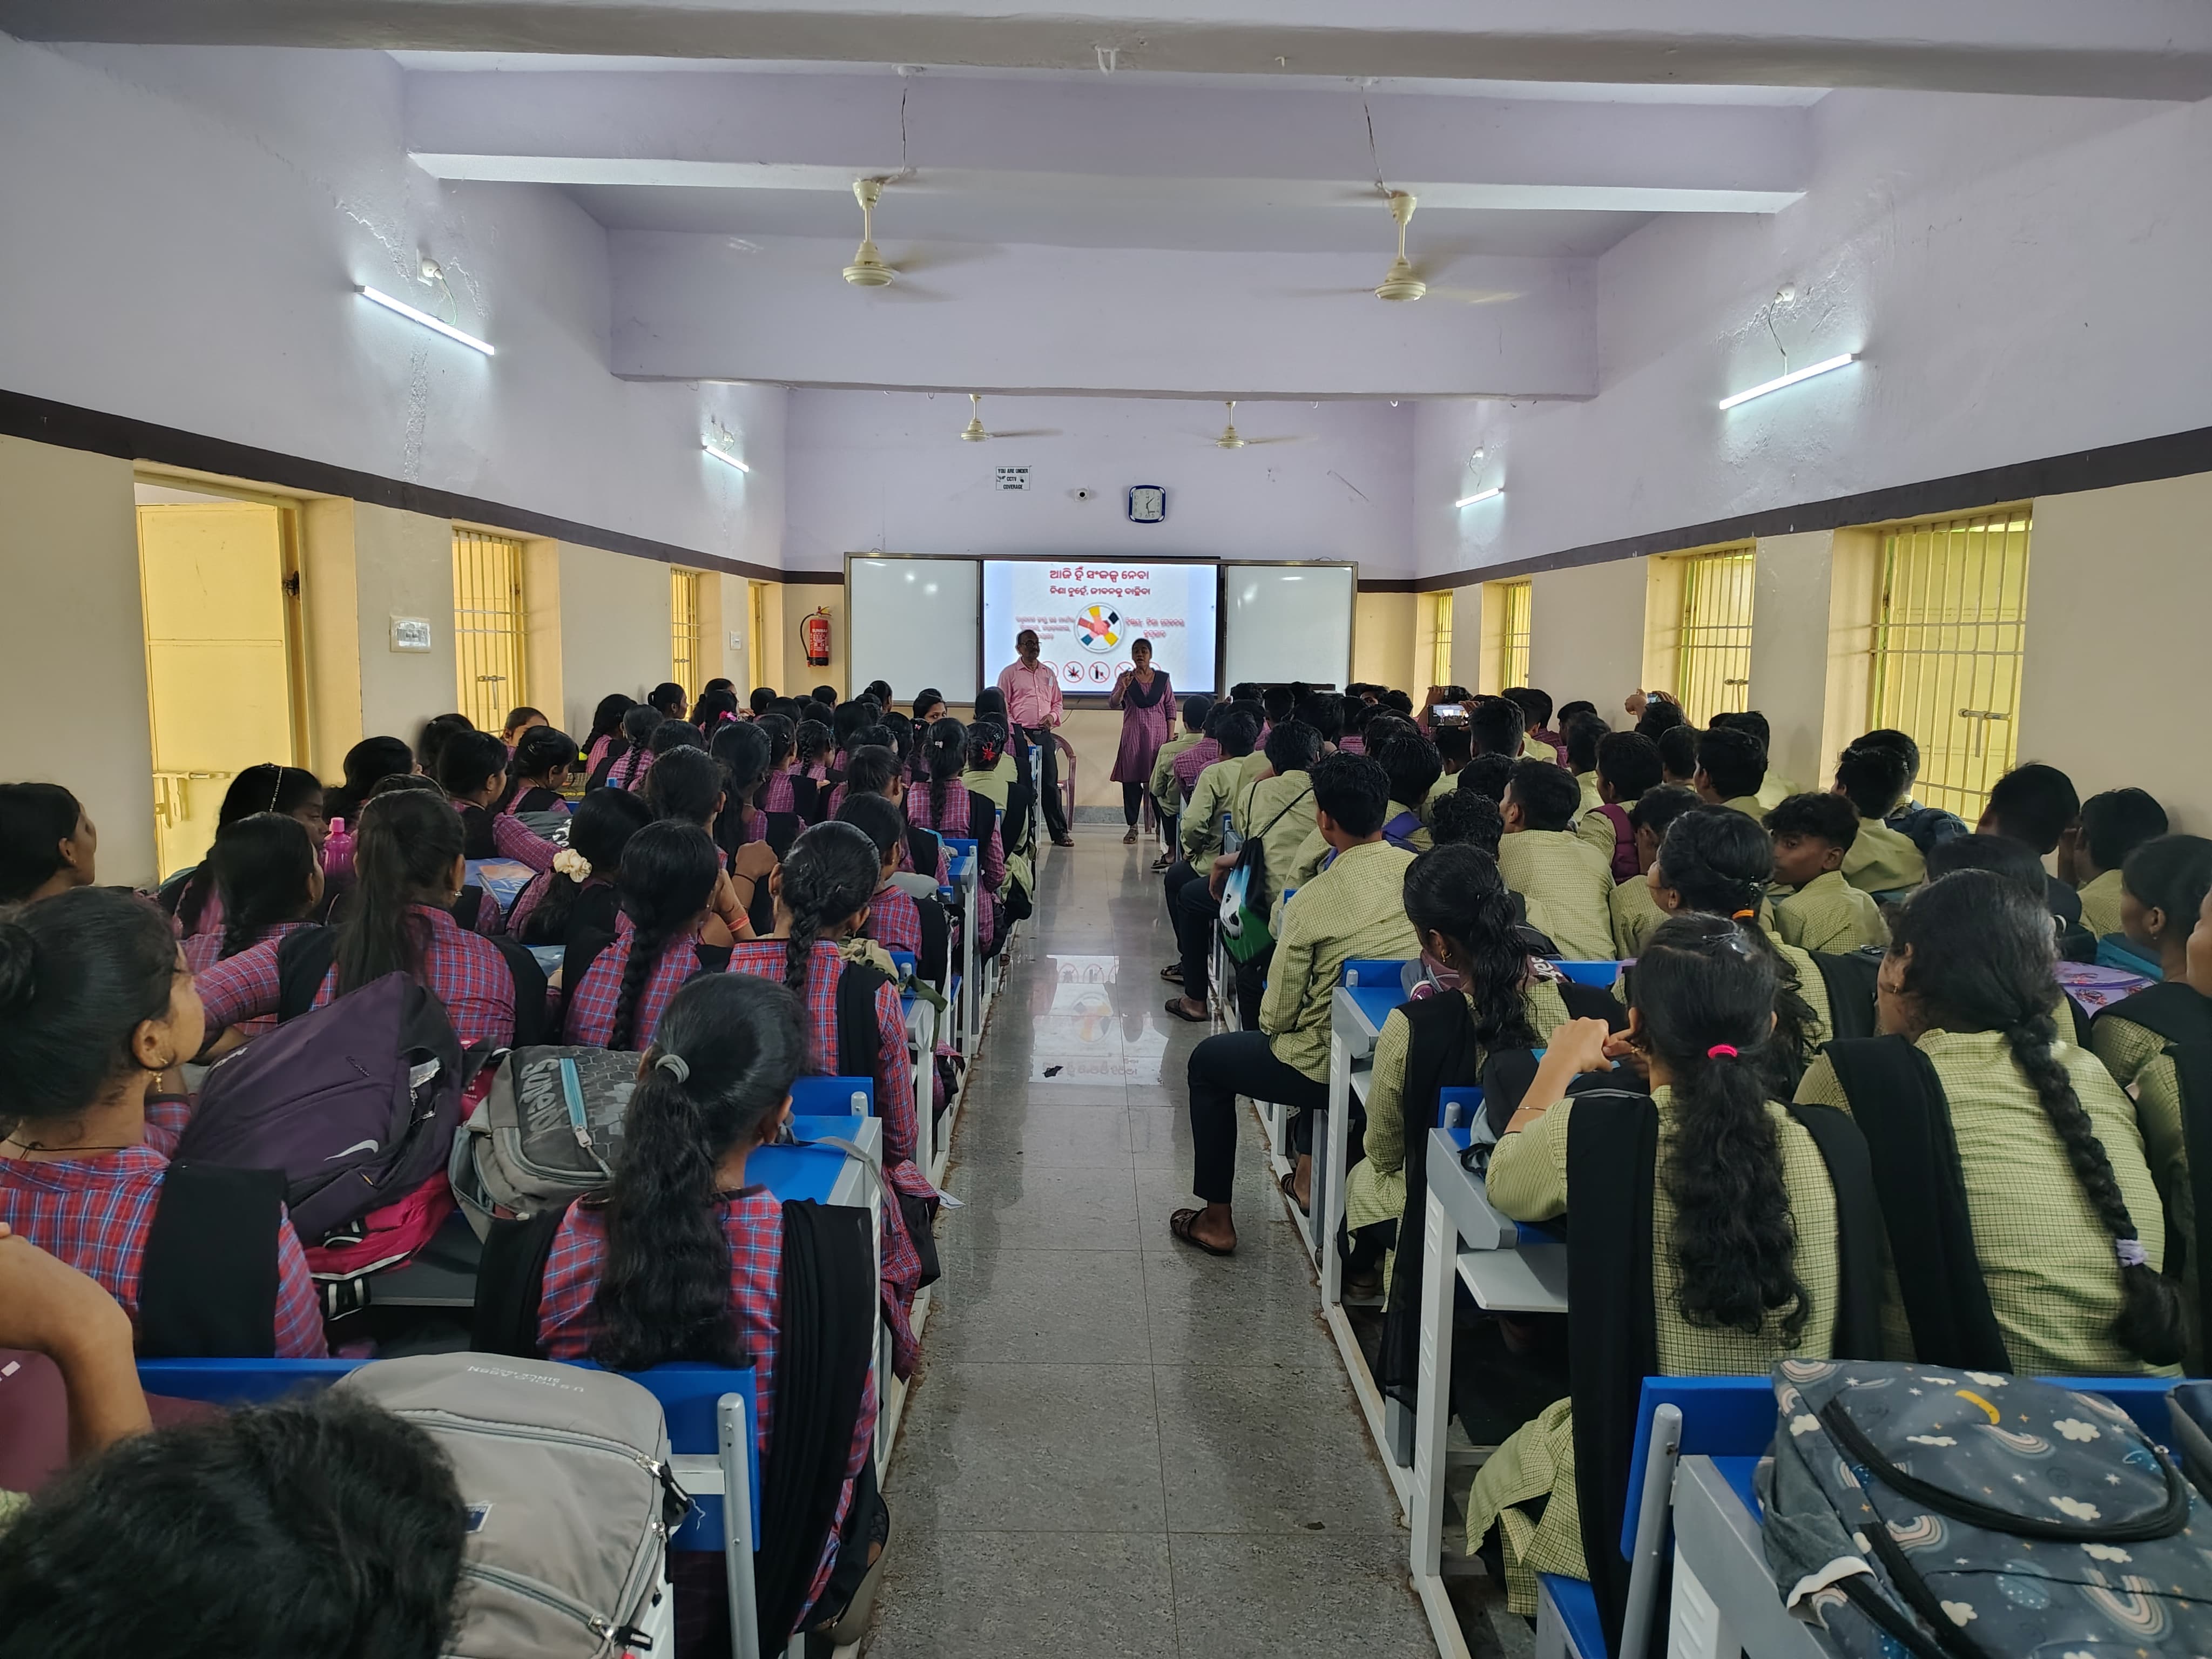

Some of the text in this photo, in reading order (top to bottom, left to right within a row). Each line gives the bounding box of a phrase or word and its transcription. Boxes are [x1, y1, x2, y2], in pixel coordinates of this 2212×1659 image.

[1050, 568, 1071, 579] ଆଜି
[1121, 571, 1149, 579] ନେବା
[1050, 585, 1066, 594] ନିଶା
[522, 1373, 561, 1383] SINCE
